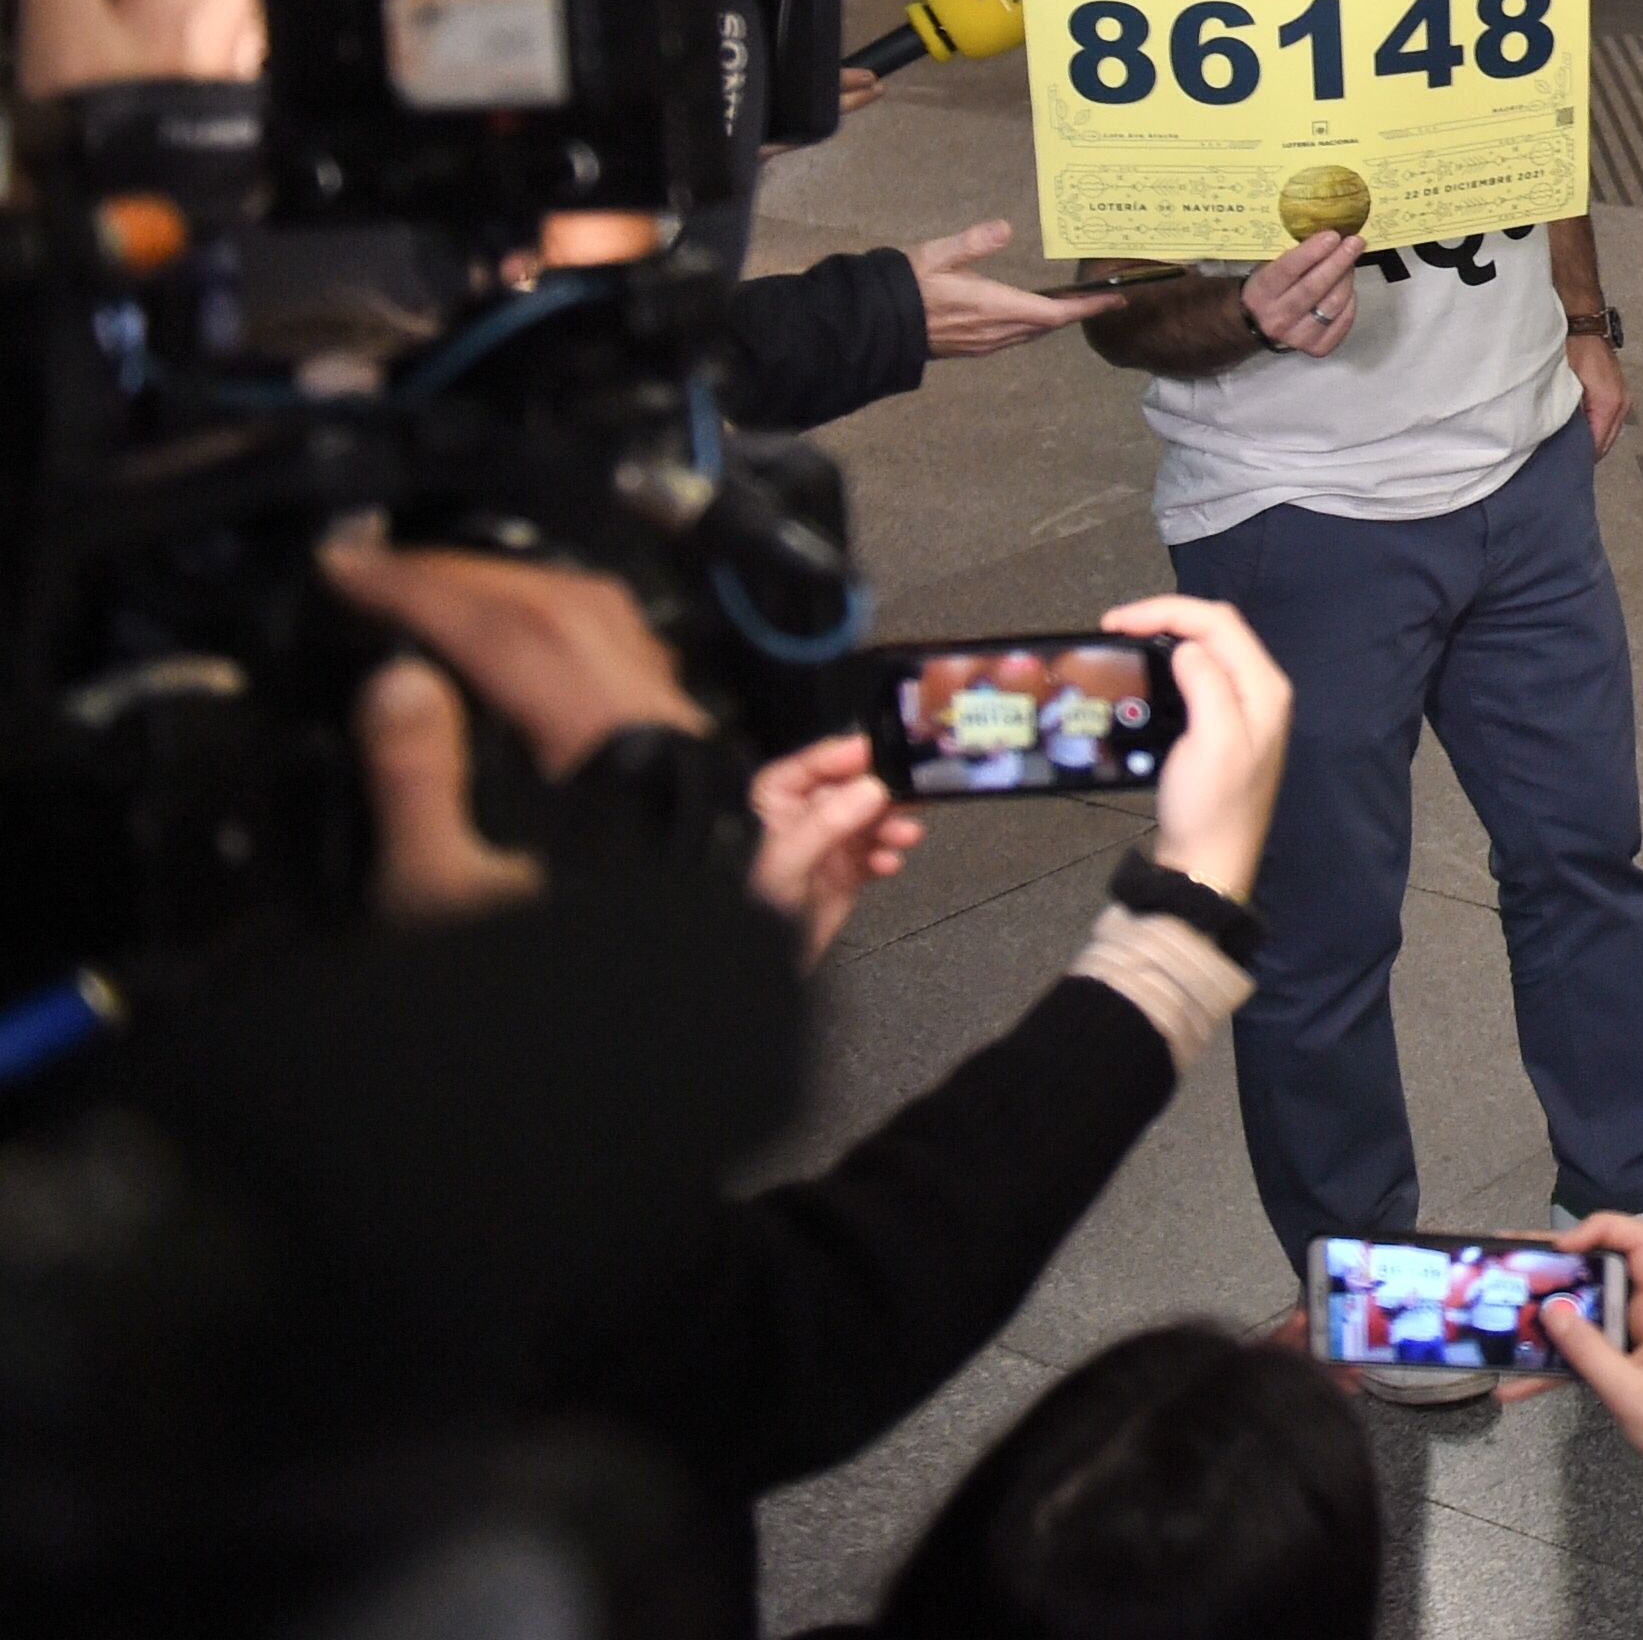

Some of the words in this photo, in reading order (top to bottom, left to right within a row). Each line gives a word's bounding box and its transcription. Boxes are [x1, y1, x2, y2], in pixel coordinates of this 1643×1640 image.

[1318, 138, 1359, 147] NACIONAL
[1404, 189, 1420, 200] 22
[1423, 187, 1440, 197] DE
[1444, 175, 1512, 193] DICIEMBRE
[1517, 169, 1545, 181] 2021
[1089, 200, 1148, 212] LOTERÍA
[1182, 204, 1245, 213] NAVIDAD
